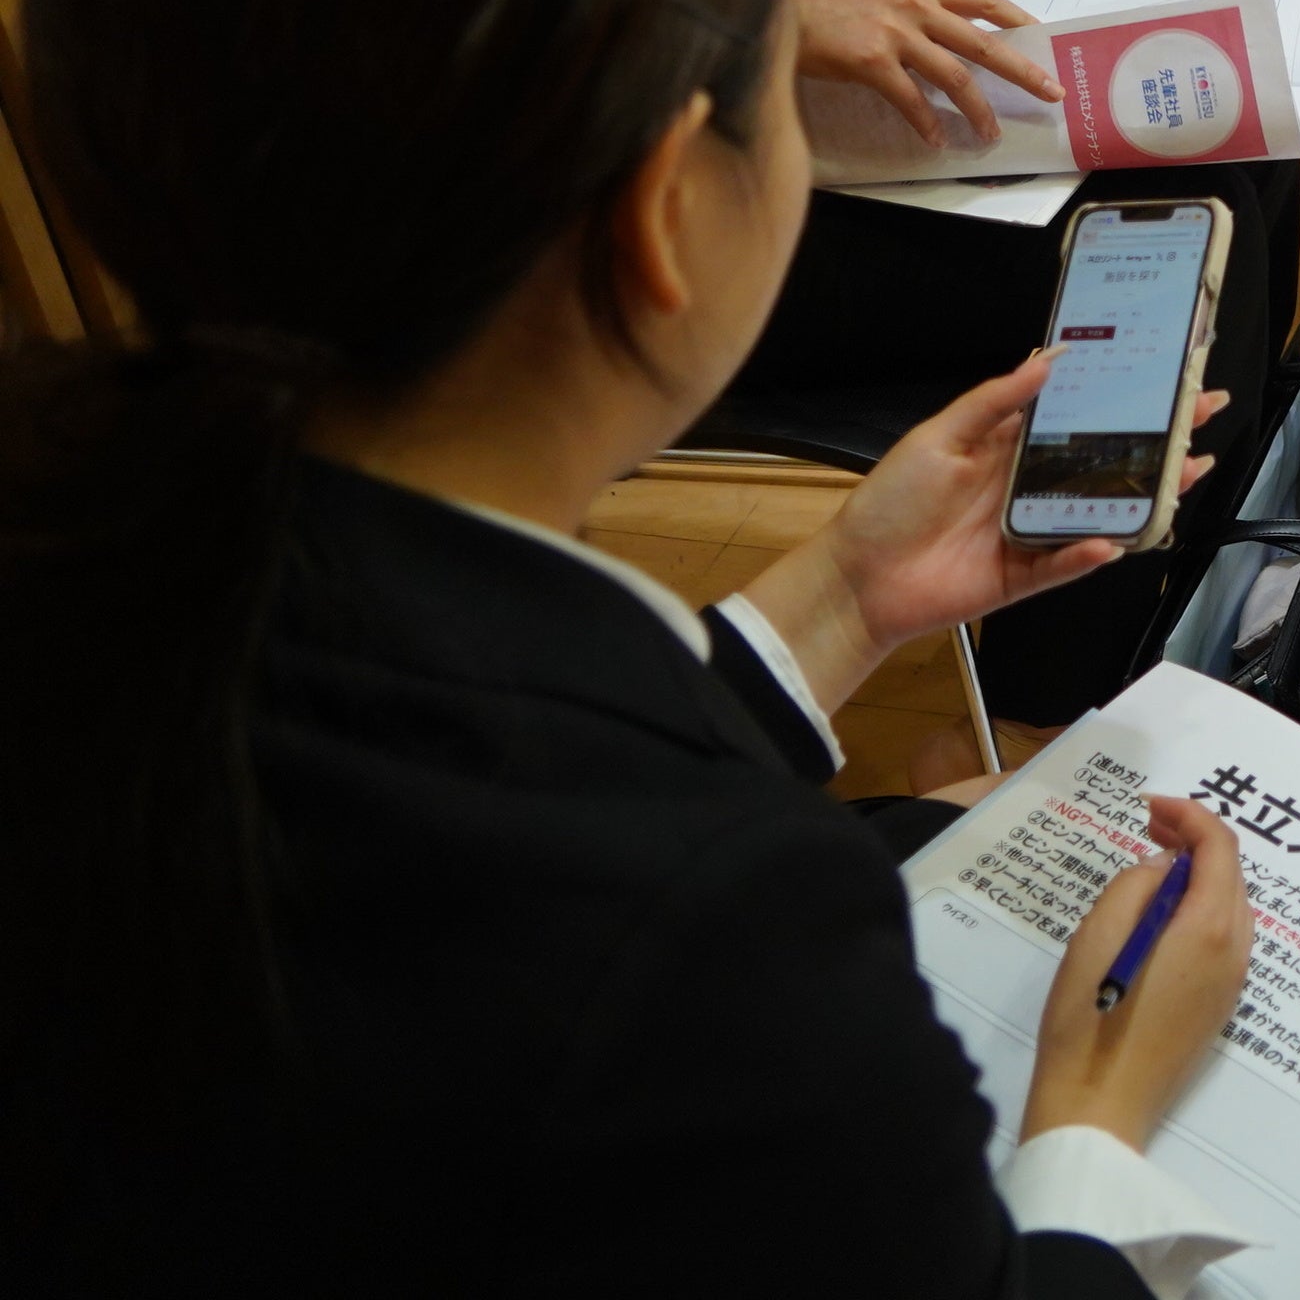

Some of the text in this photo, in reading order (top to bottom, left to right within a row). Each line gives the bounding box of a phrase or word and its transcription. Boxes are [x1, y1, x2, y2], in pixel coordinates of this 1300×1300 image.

[1069, 45, 1104, 167] 株式会社共立メンテナンス
[1141, 79, 1164, 125] 座談会
[1158, 68, 1184, 129] 先輩社員
[958, 868, 1074, 943] ⑤早くビンゴを達
[976, 853, 1086, 922] ④リーチになった
